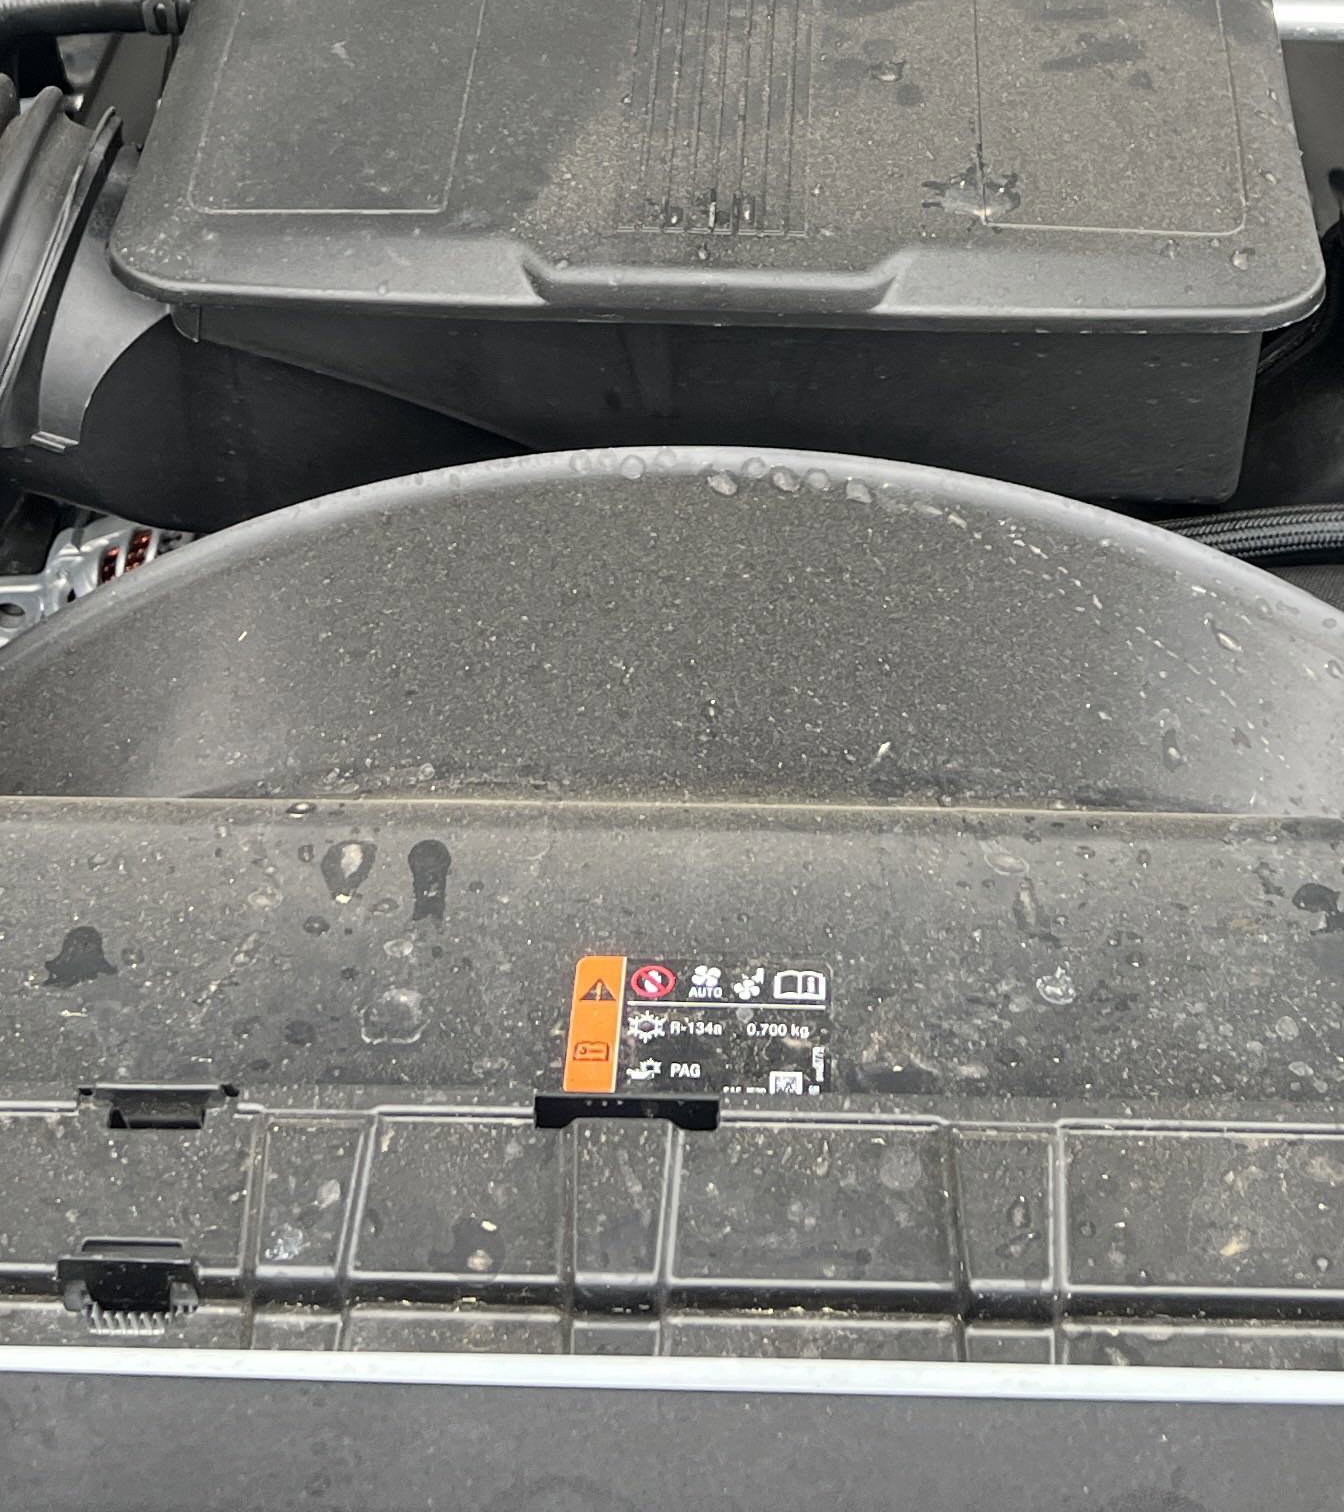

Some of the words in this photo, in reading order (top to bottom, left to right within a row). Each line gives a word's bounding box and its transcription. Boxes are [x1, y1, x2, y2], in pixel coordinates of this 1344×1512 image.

[688, 986, 723, 999] AUTO
[670, 1021, 723, 1036] R-134a
[746, 1023, 788, 1037] 0.700
[791, 1024, 810, 1039] kg
[670, 1063, 701, 1078] PAG
